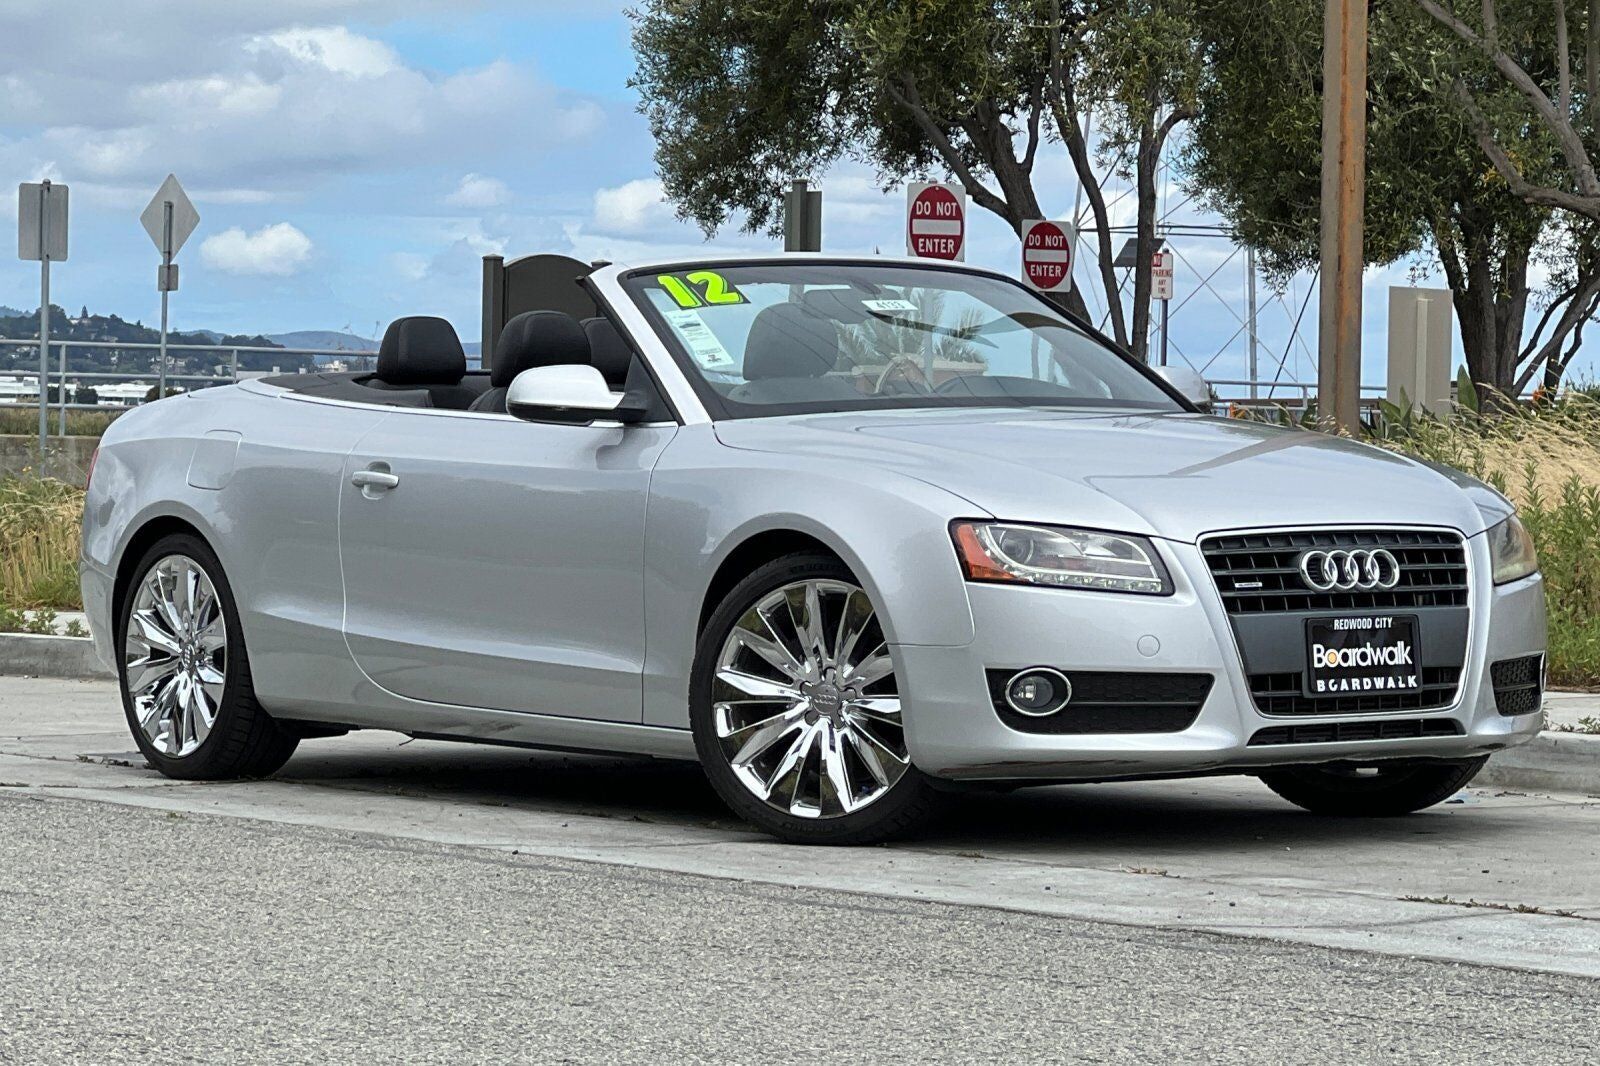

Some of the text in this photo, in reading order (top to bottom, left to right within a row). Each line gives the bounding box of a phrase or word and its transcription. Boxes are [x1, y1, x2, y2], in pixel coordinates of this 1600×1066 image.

[916, 201, 957, 217] DO NOT
[918, 238, 955, 253] ENTER
[1028, 234, 1064, 248] DO NOT
[1030, 264, 1062, 277] ENTER
[1153, 269, 1172, 277] PARKING
[657, 271, 743, 307] 12
[1334, 617, 1393, 630] REDWOOD CITY
[1312, 640, 1413, 668] Boardwalk
[1316, 675, 1417, 692] BOARDWALK
